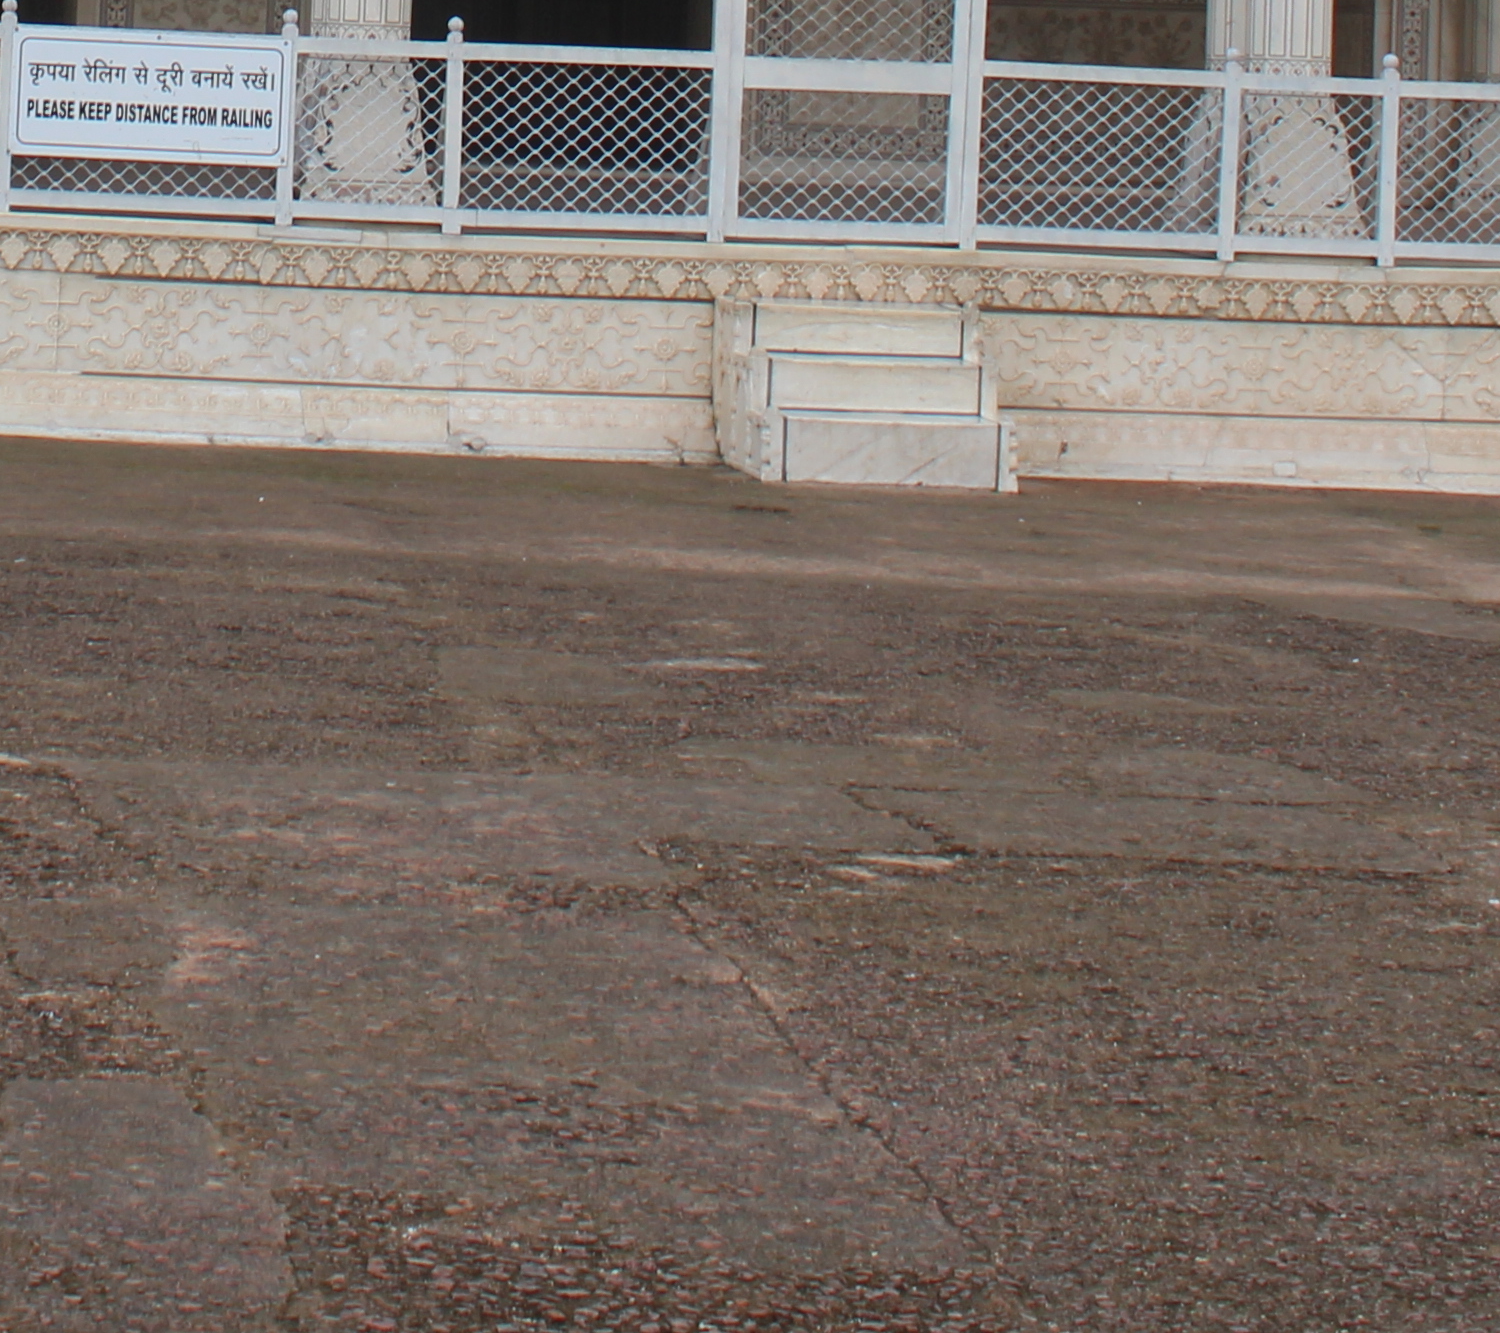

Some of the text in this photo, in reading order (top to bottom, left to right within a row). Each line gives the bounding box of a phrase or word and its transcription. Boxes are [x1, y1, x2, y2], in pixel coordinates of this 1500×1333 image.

[28, 62, 76, 86] कृपया
[82, 57, 126, 84] रेलिंग
[132, 59, 149, 85] से
[155, 61, 184, 93] दूरी
[27, 99, 273, 129] PLEASE KEEP DISTANCE FROM RAILING
